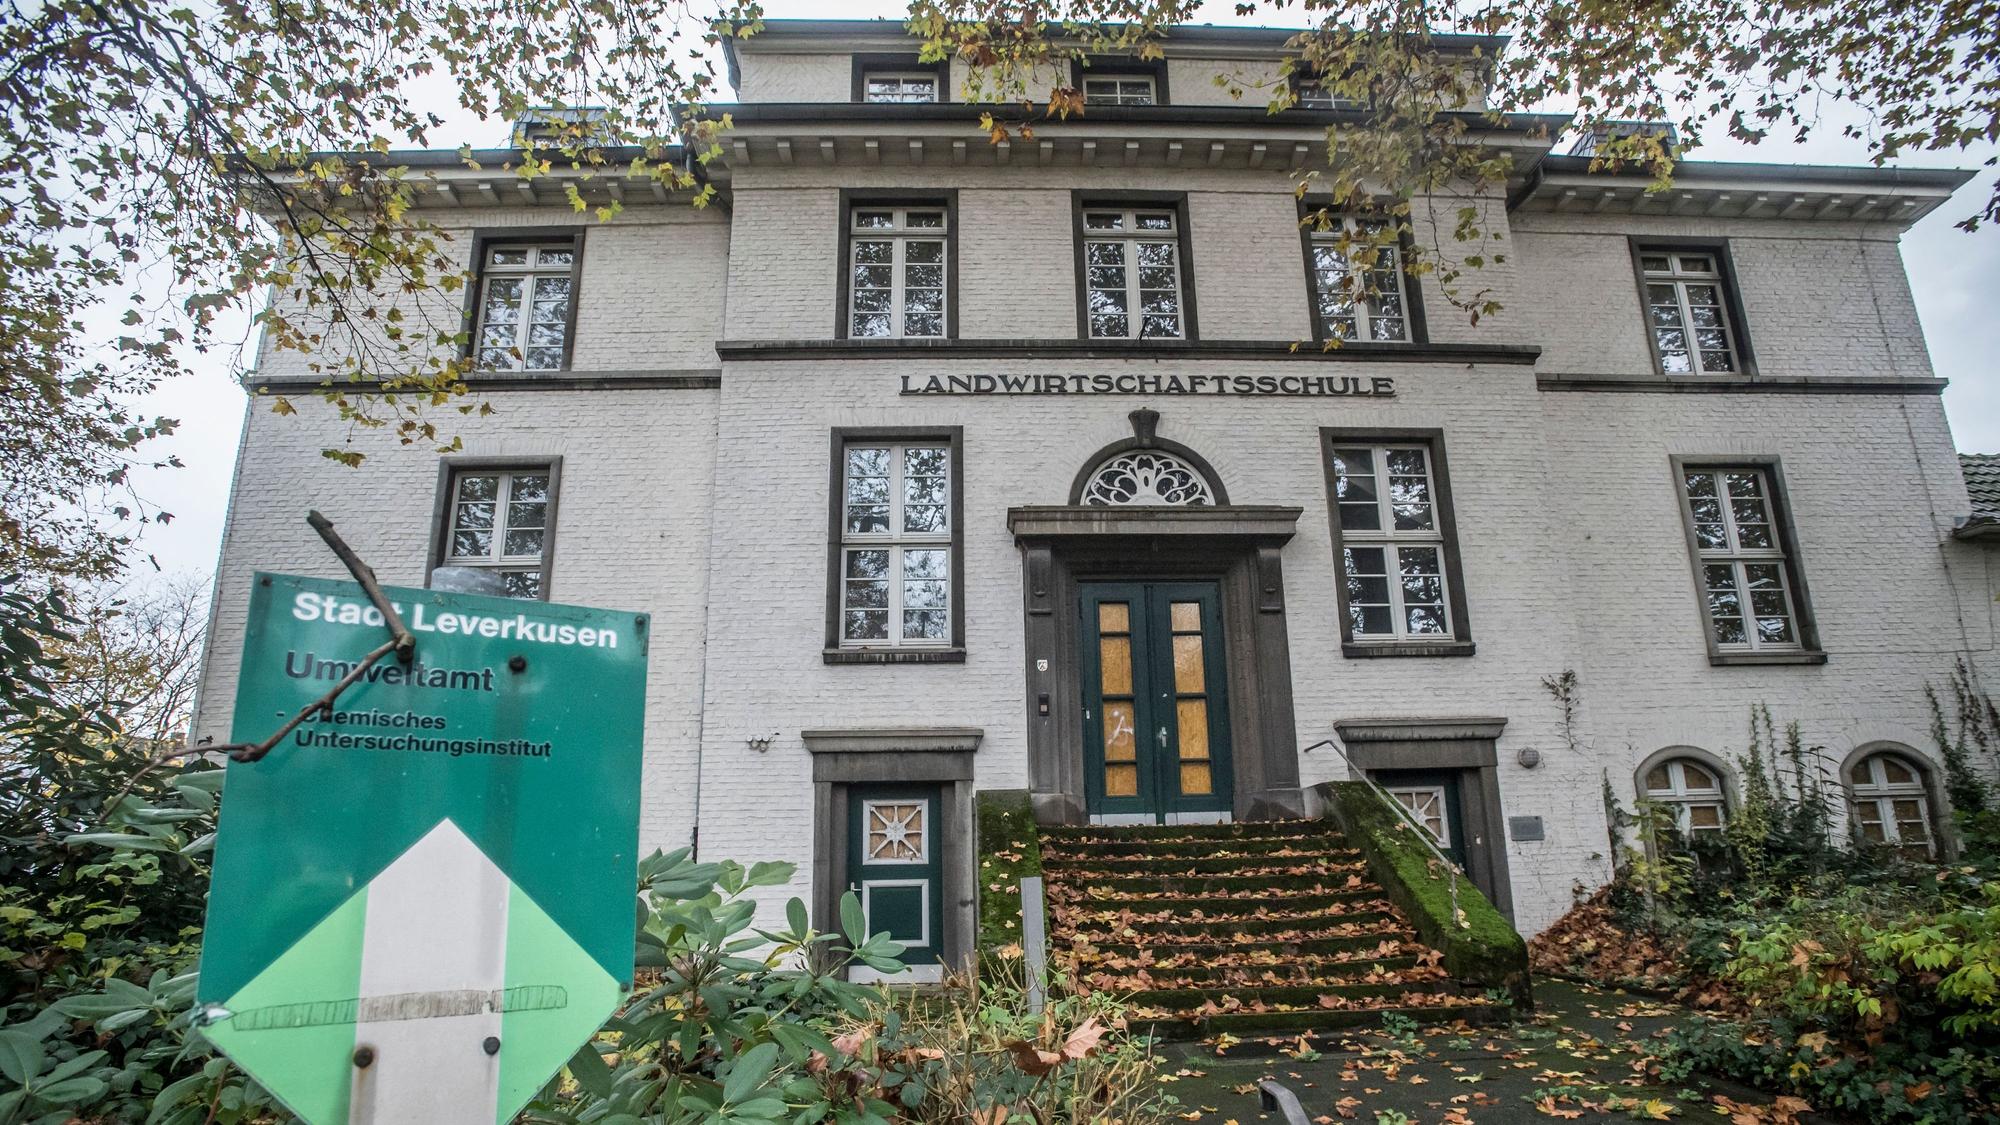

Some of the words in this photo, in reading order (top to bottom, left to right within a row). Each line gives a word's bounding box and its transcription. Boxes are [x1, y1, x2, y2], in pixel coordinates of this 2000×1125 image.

[900, 374, 1396, 395] LANDWIRTSCHAFTSSCHULE
[412, 603, 618, 649] Leverkusen
[285, 651, 493, 691] Umweltamt
[295, 729, 552, 757] Untersuchungsinstitut
